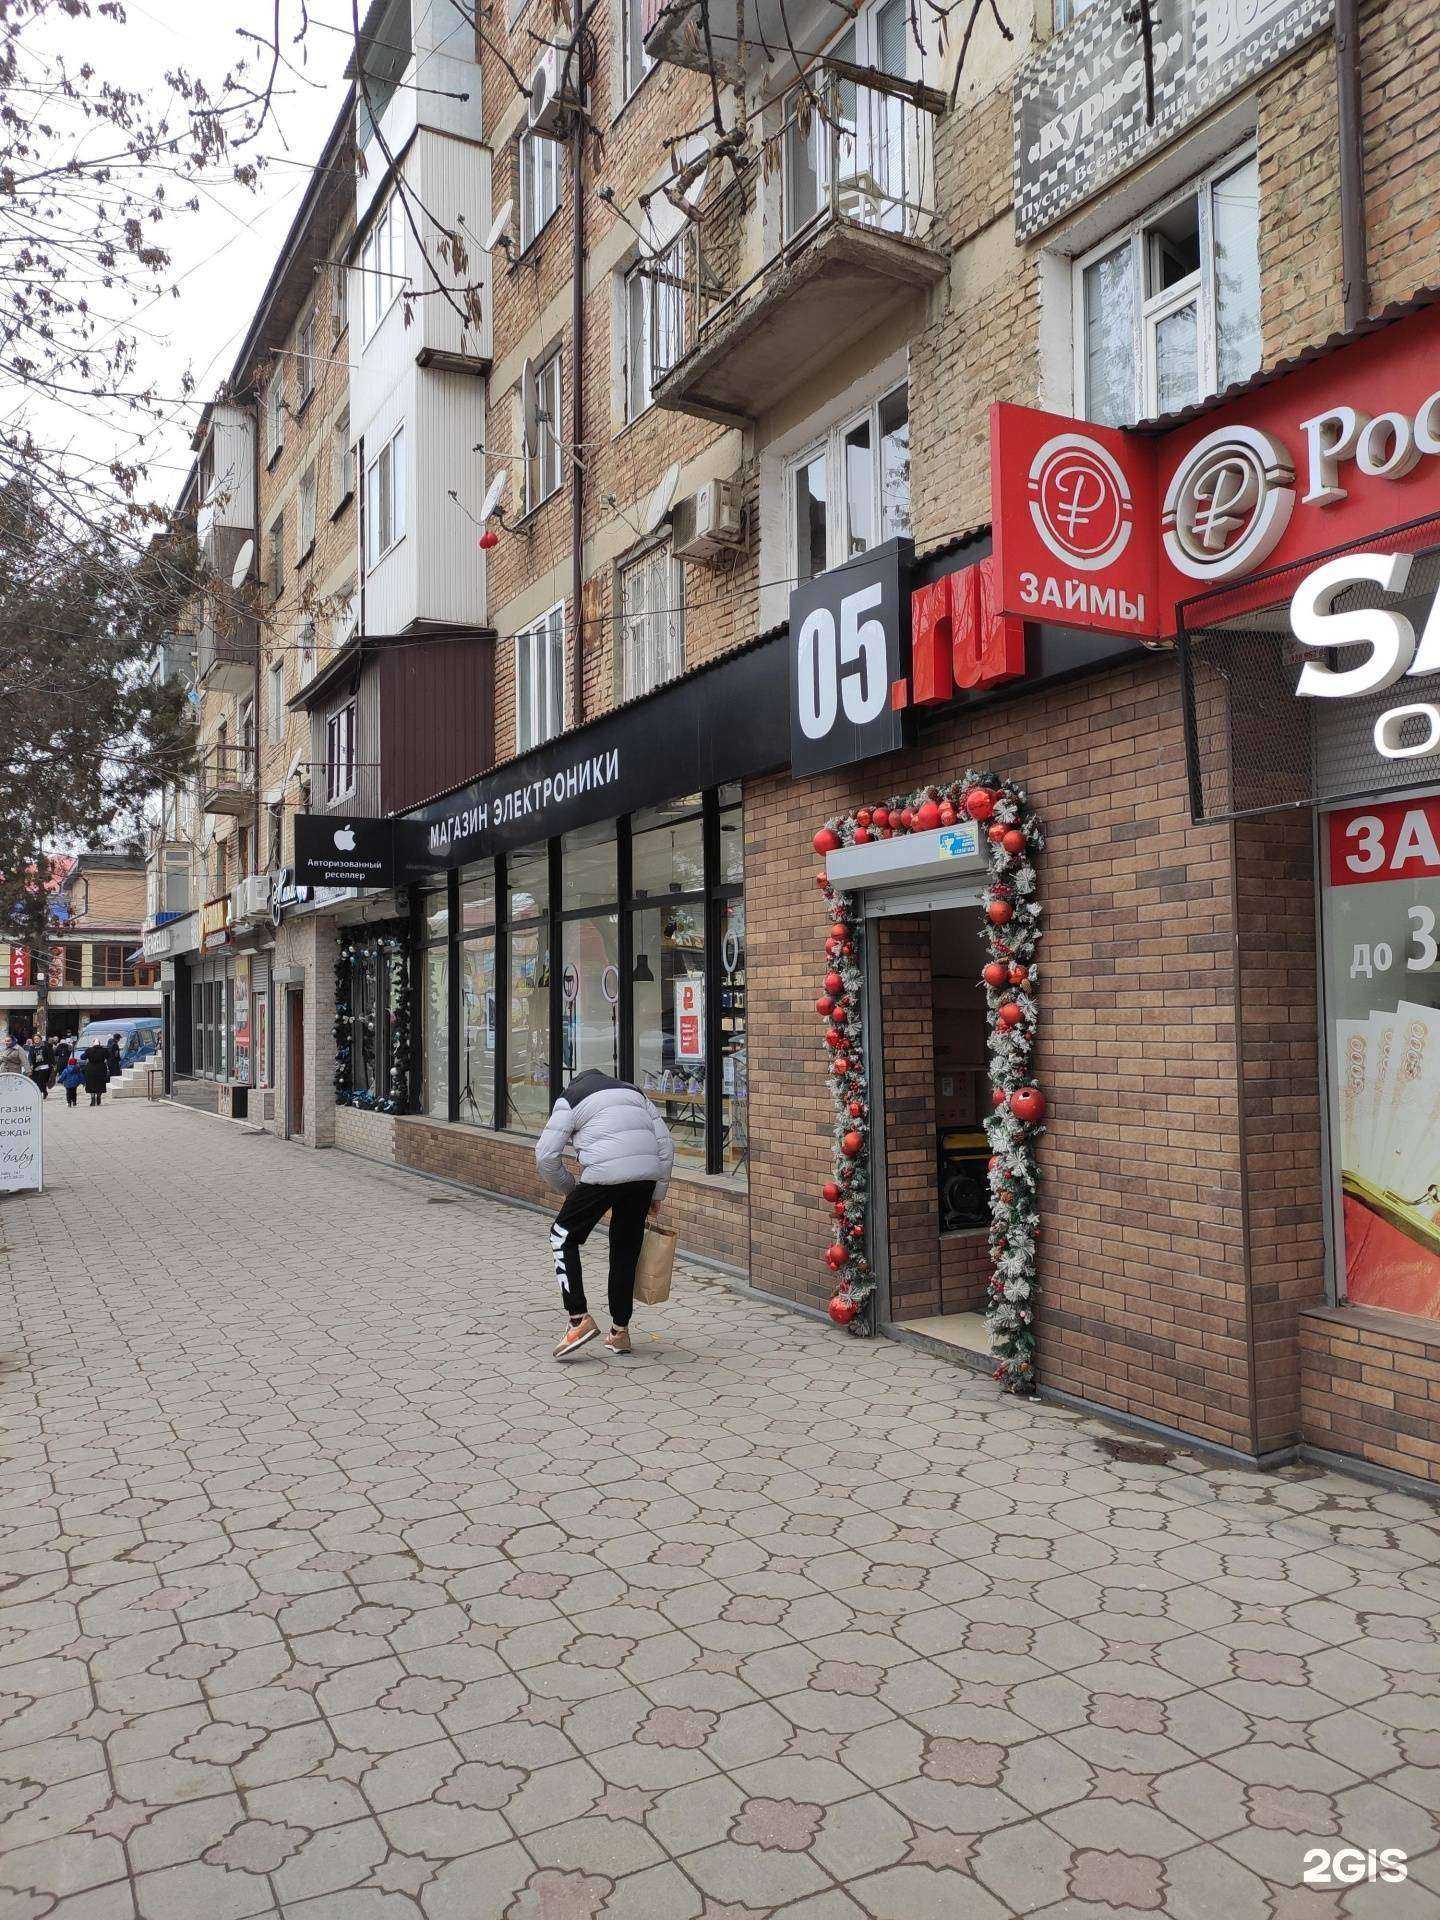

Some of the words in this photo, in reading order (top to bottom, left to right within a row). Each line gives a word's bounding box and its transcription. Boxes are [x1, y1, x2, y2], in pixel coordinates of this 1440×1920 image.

[1021, 183, 1070, 222] Пусть
[1019, 572, 1145, 622] ЗАЙМЫ
[430, 804, 488, 849] МАГАЗИН
[493, 748, 619, 826] ЭЛЕКТРОНИКИ
[307, 858, 382, 869] Авторизованный
[325, 871, 366, 880] реселлер
[14, 947, 25, 986] КАФЕ
[1350, 942, 1393, 979] до
